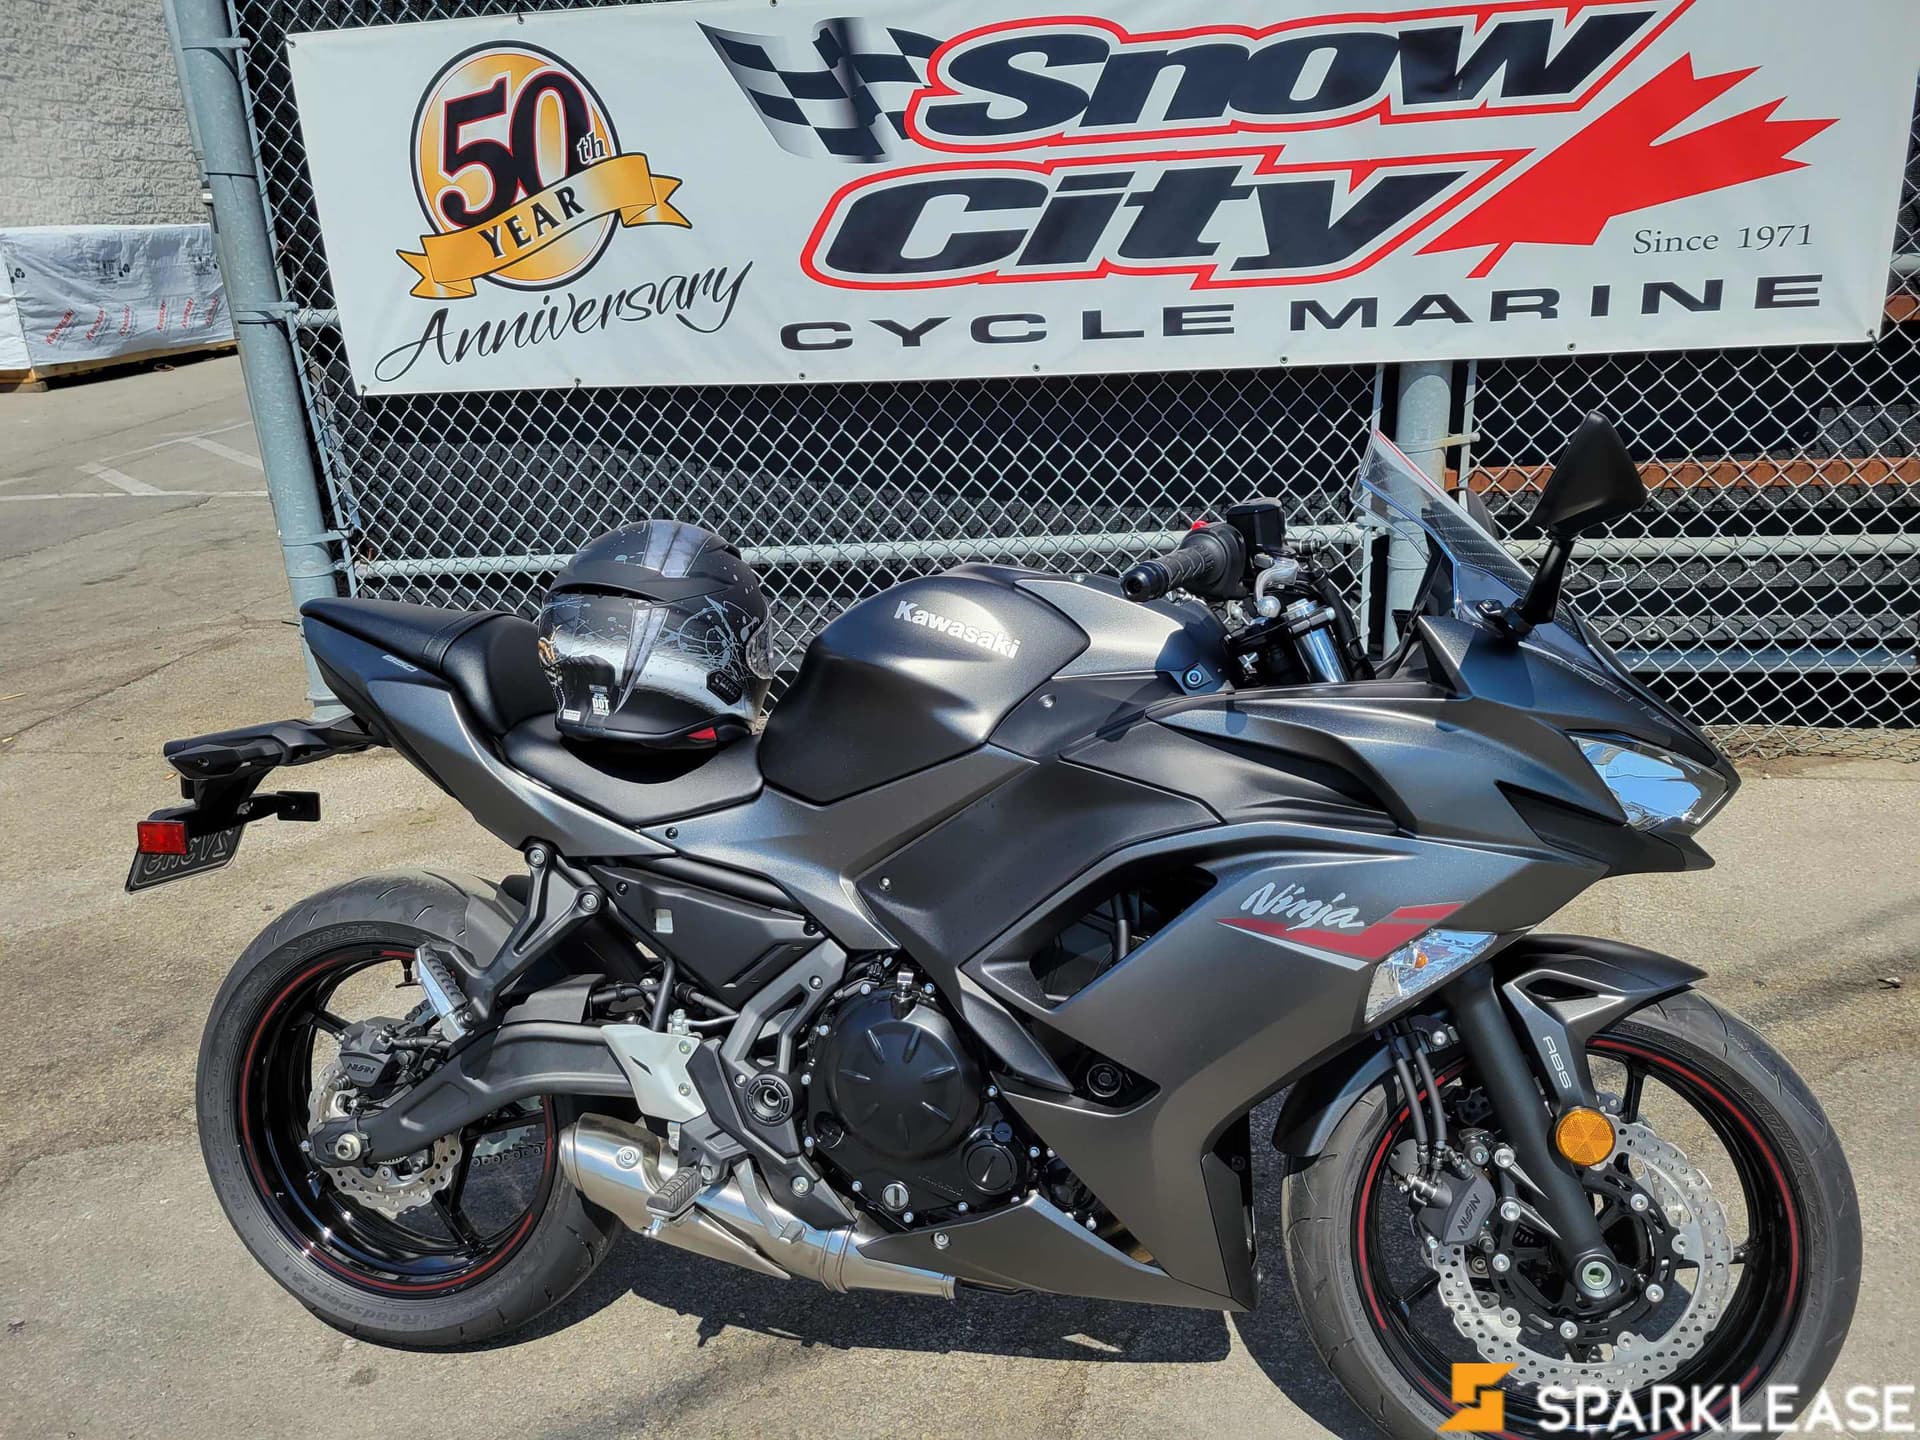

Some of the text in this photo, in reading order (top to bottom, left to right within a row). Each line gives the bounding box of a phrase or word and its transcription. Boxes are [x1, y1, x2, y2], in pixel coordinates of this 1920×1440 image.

[925, 11, 1657, 137] Snow
[477, 186, 585, 258] YEAR
[826, 165, 1468, 274] City
[1633, 223, 1813, 254] Since 1971
[374, 261, 754, 382] Anniversary
[780, 274, 1823, 351] CYCLE MARINE
[893, 600, 1021, 659] Kawasaki
[1240, 882, 1365, 931] Ninja
[1543, 1035, 1572, 1089] ABS
